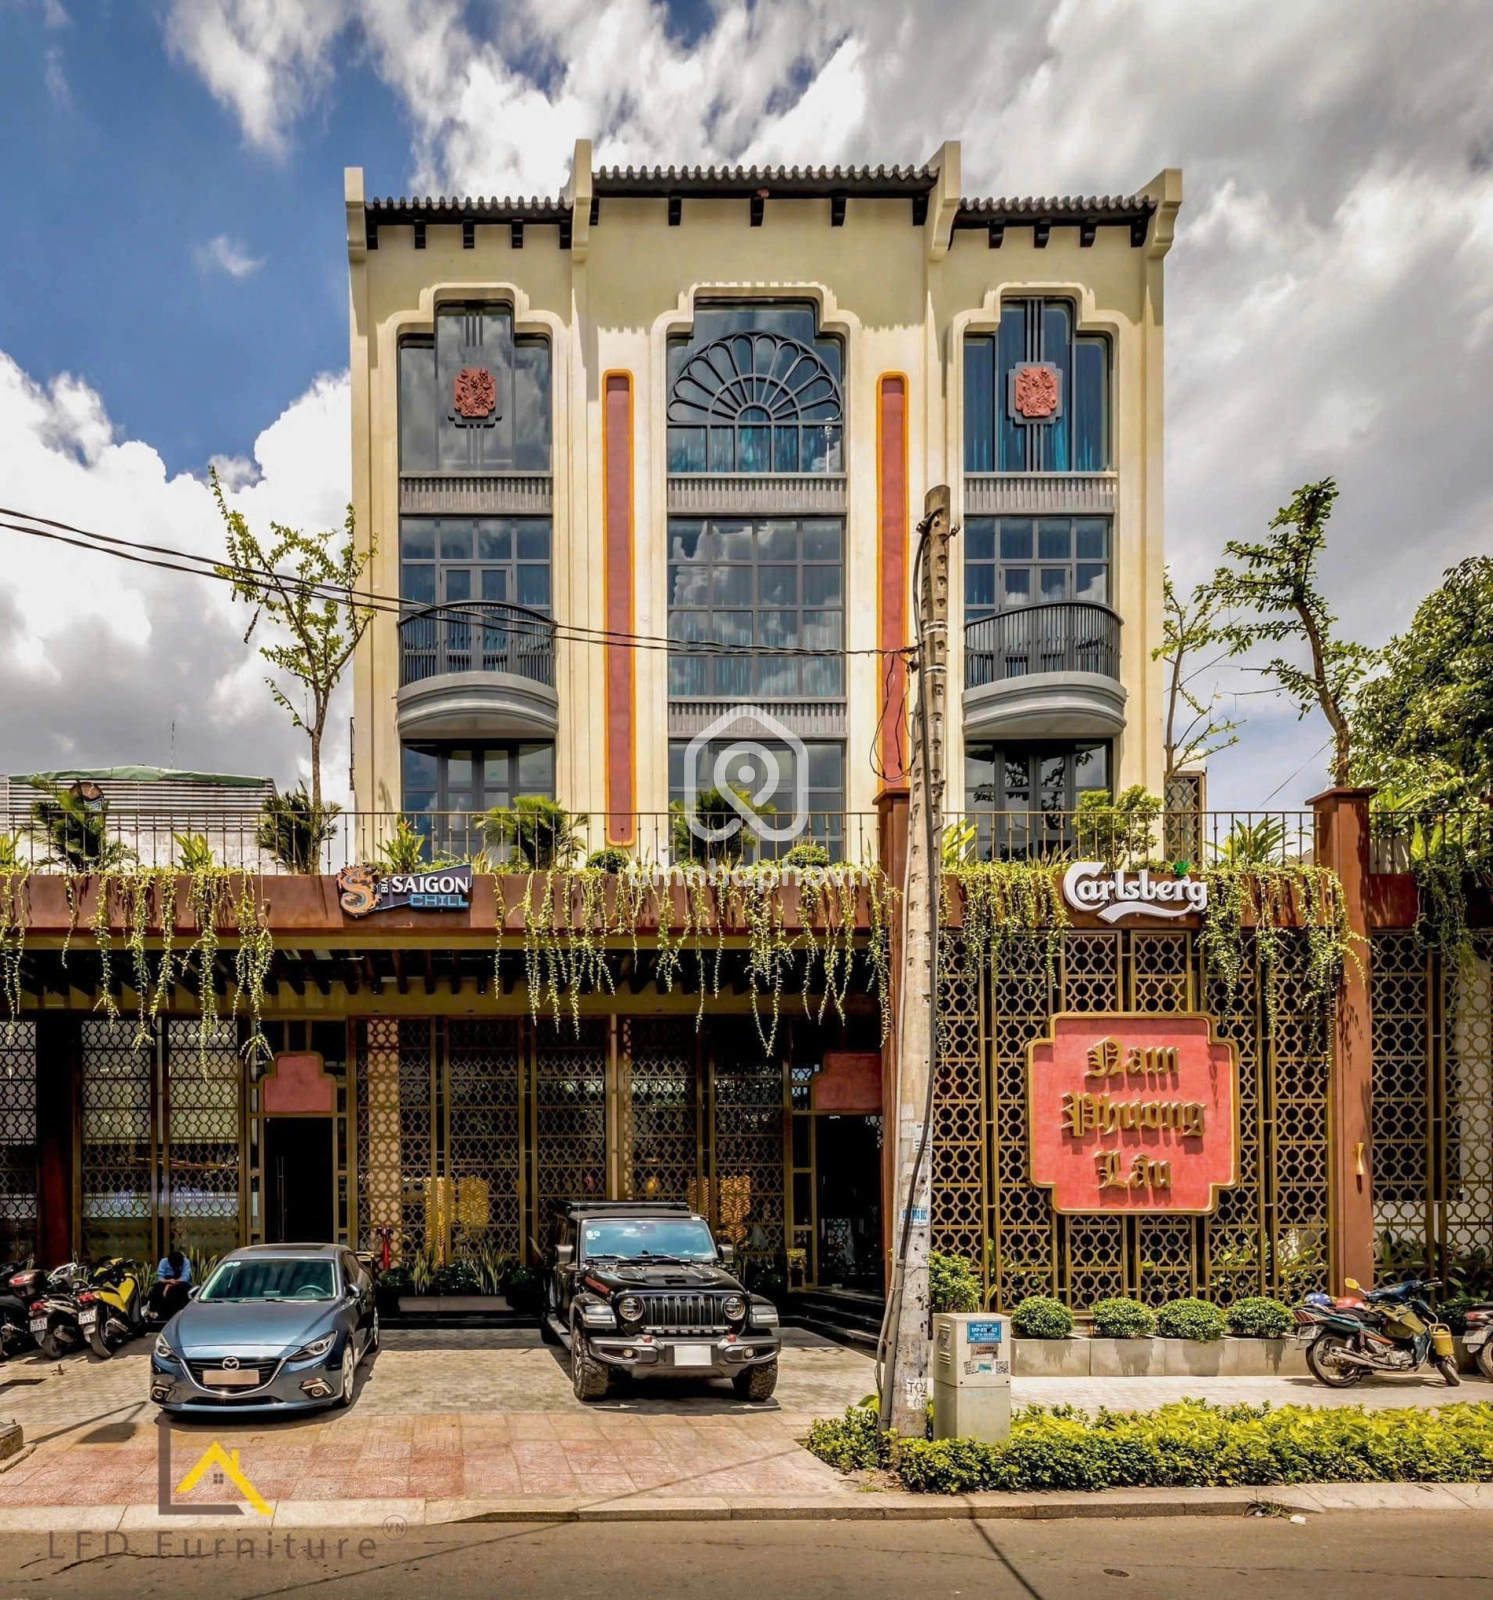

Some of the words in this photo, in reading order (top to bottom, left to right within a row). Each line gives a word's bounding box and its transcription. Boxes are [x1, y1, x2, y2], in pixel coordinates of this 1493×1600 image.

[380, 877, 389, 893] BIA
[392, 876, 469, 894] SAIGON
[1063, 862, 1208, 916] Carlsberg
[409, 894, 469, 908] CHILL
[1084, 1037, 1180, 1078] Nam
[1094, 1151, 1172, 1189] Lâu
